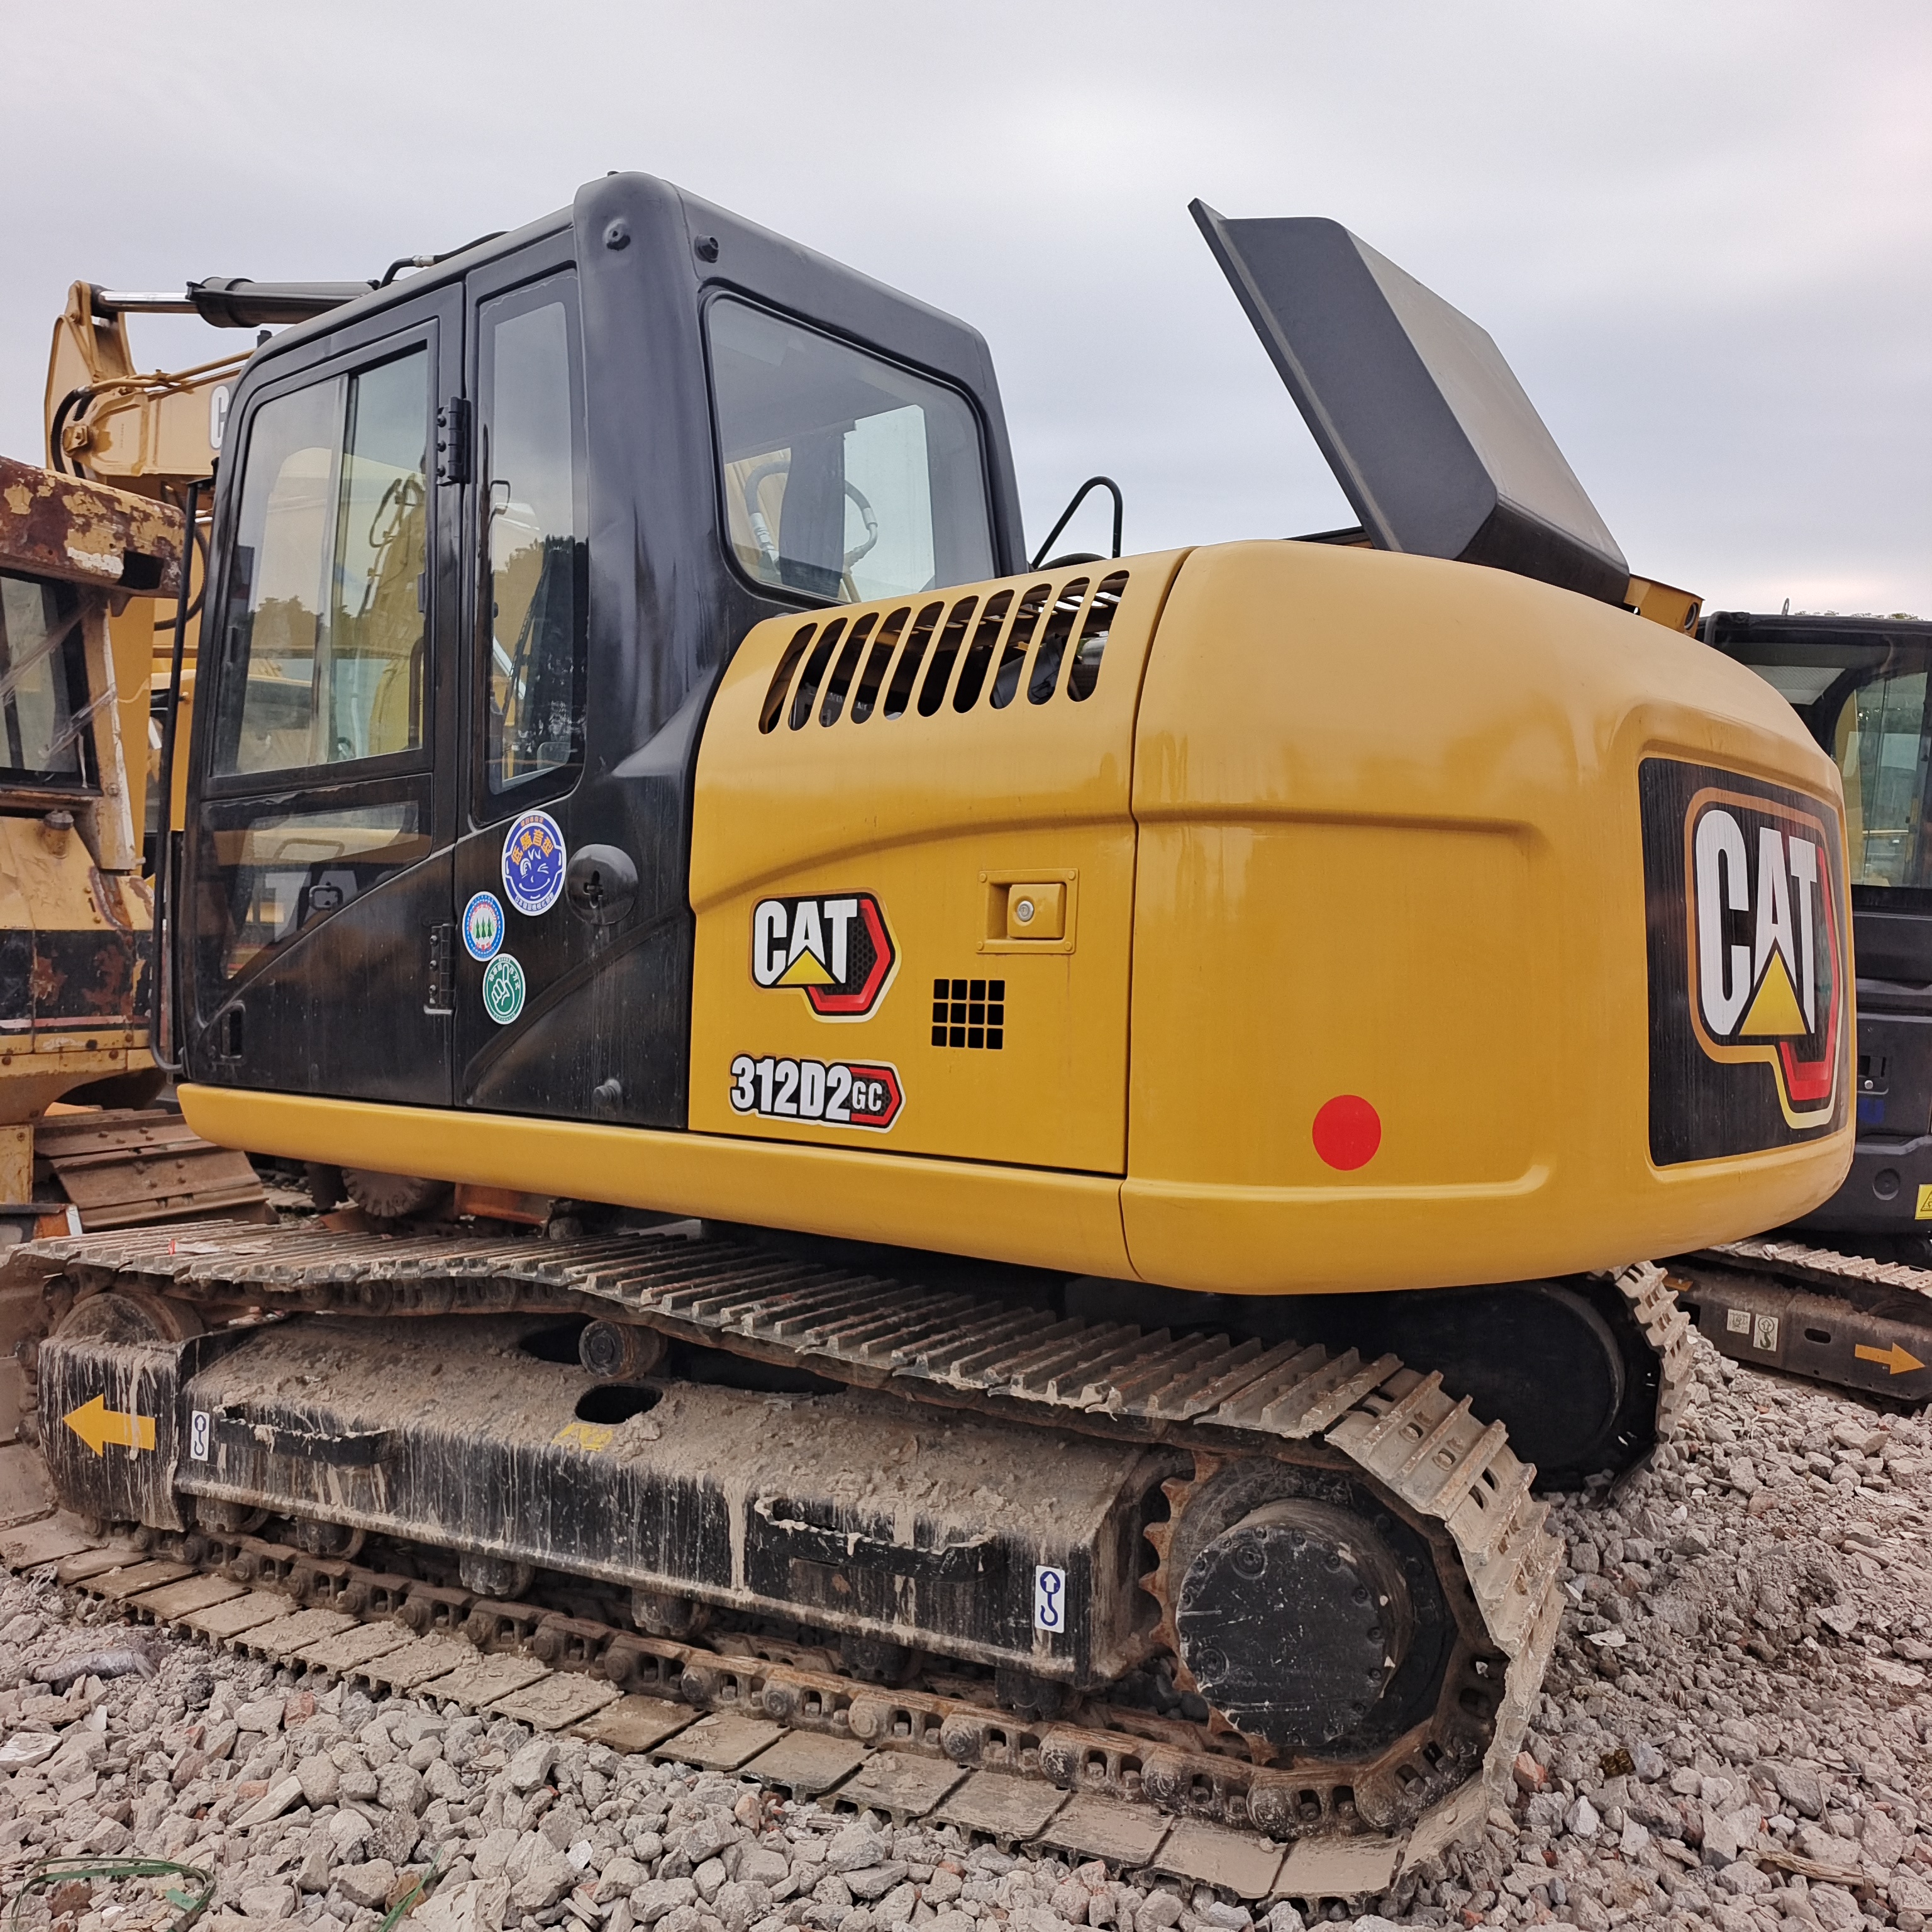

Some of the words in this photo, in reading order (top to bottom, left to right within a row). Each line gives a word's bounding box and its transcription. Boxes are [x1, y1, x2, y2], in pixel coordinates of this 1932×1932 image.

[754, 899, 858, 985] CAT
[1696, 809, 1818, 1036] CAT
[731, 1056, 853, 1121] 312D2
[852, 1080, 882, 1111] GC
